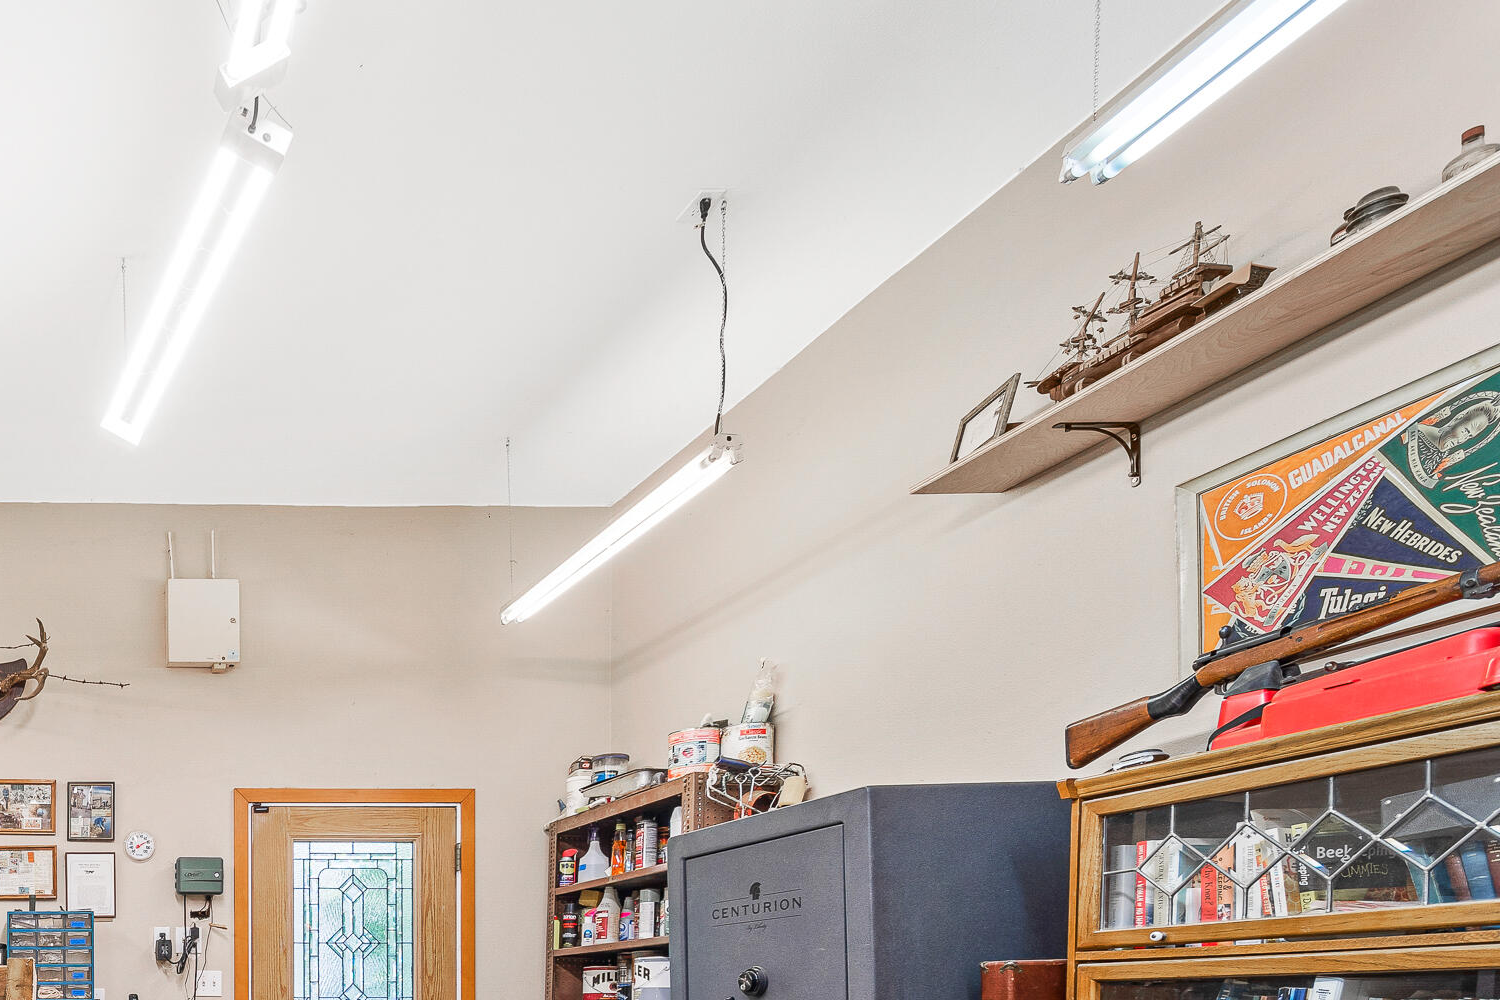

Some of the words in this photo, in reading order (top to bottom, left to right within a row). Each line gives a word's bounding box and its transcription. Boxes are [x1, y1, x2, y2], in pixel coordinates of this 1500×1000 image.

[1287, 411, 1408, 490] GUADALCANAL
[1219, 489, 1240, 521] BRITISH
[1245, 479, 1281, 493] SOLOMON
[1240, 513, 1273, 536] ISLANDS
[1322, 507, 1349, 533] NEW
[1362, 506, 1397, 535] NEW
[1392, 519, 1463, 564] HEBRIDES
[1341, 863, 1390, 878] UMMIES
[1204, 880, 1213, 906] Knot?
[712, 896, 802, 920] CENTURION
